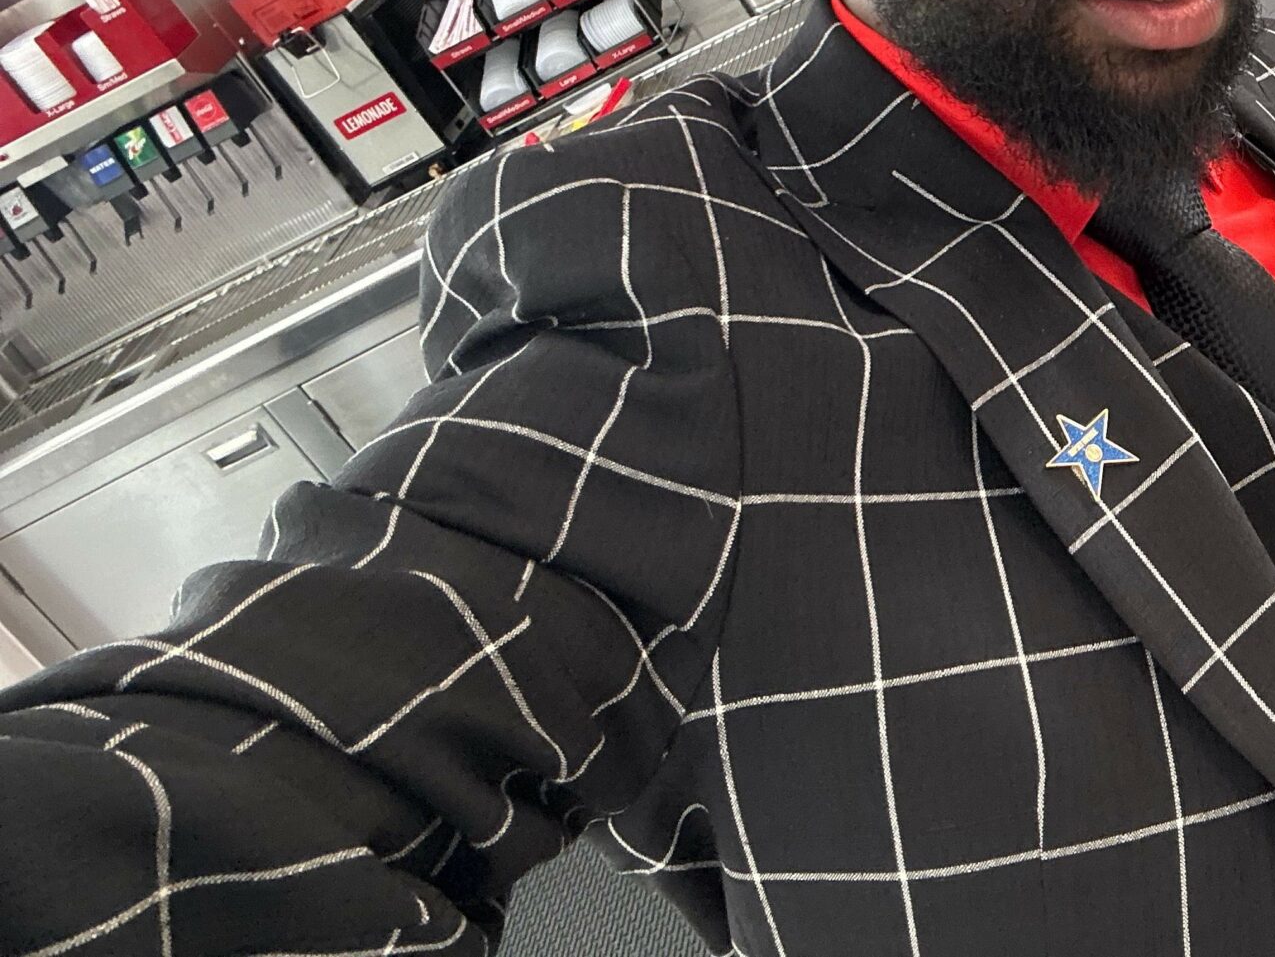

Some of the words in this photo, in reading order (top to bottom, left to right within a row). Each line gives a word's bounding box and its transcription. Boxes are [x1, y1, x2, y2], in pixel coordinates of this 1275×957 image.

[100, 7, 127, 23] Straws
[450, 45, 473, 59] Straws
[612, 43, 636, 59] X-Large
[559, 74, 577, 88] Large
[46, 99, 75, 117] X-Large
[341, 97, 398, 134] LEMONADE
